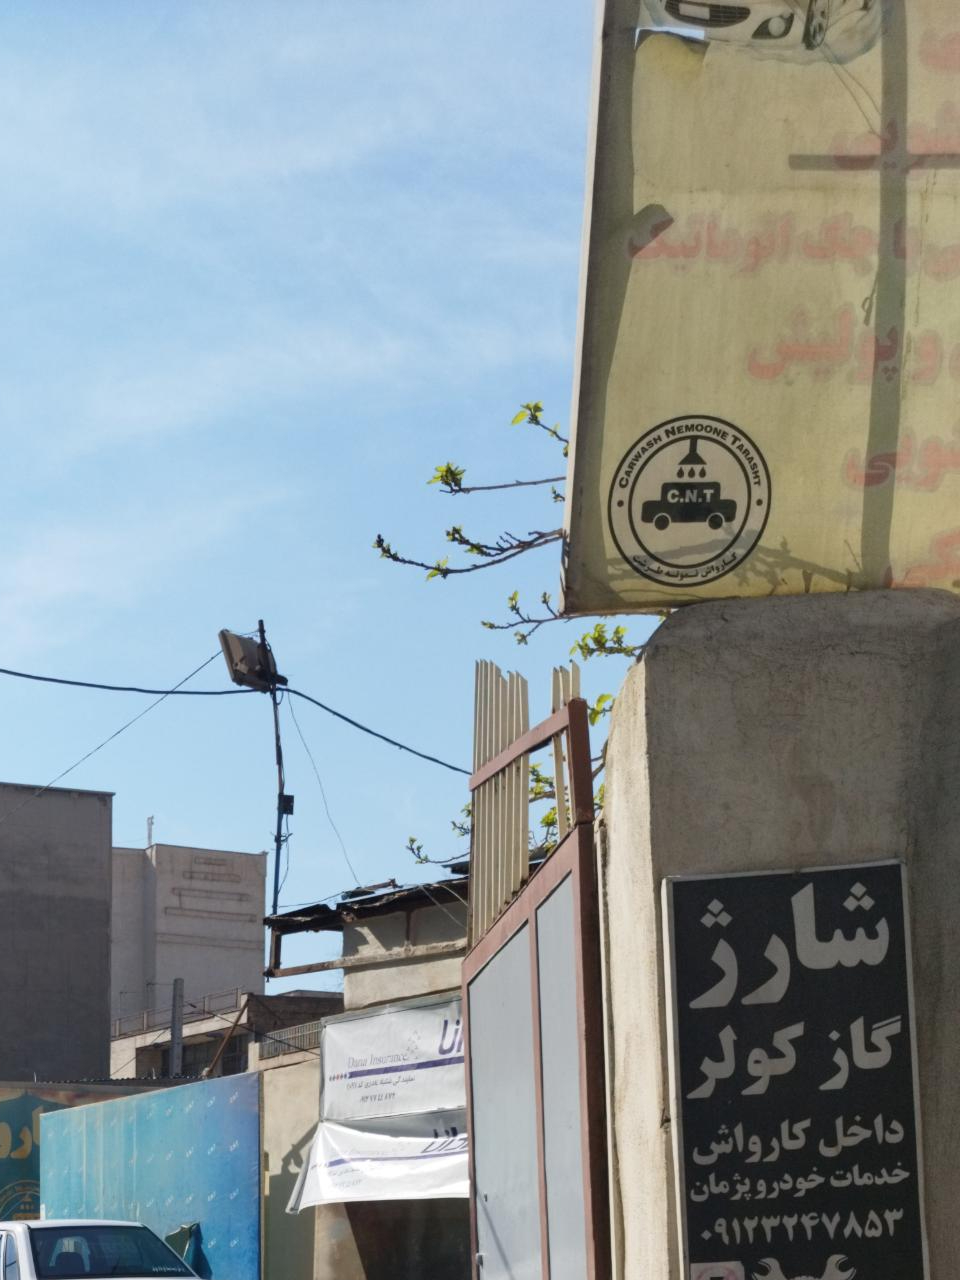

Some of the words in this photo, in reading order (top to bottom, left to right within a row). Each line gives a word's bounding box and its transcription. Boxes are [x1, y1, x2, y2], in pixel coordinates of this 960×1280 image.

[665, 424, 728, 440] NEMOONE
[667, 489, 714, 503] C.N.T
[689, 882, 889, 1009] شارژ
[686, 1021, 805, 1099] کولر
[818, 1015, 902, 1091] گاز
[692, 1118, 811, 1165] کارواش
[818, 1113, 905, 1157] داخل
[690, 1172, 751, 1202] پژمان
[829, 1161, 911, 1188] خدمات
[701, 1207, 904, 1246] ۰۹۱۲۳۲۴۷۸۵۳
